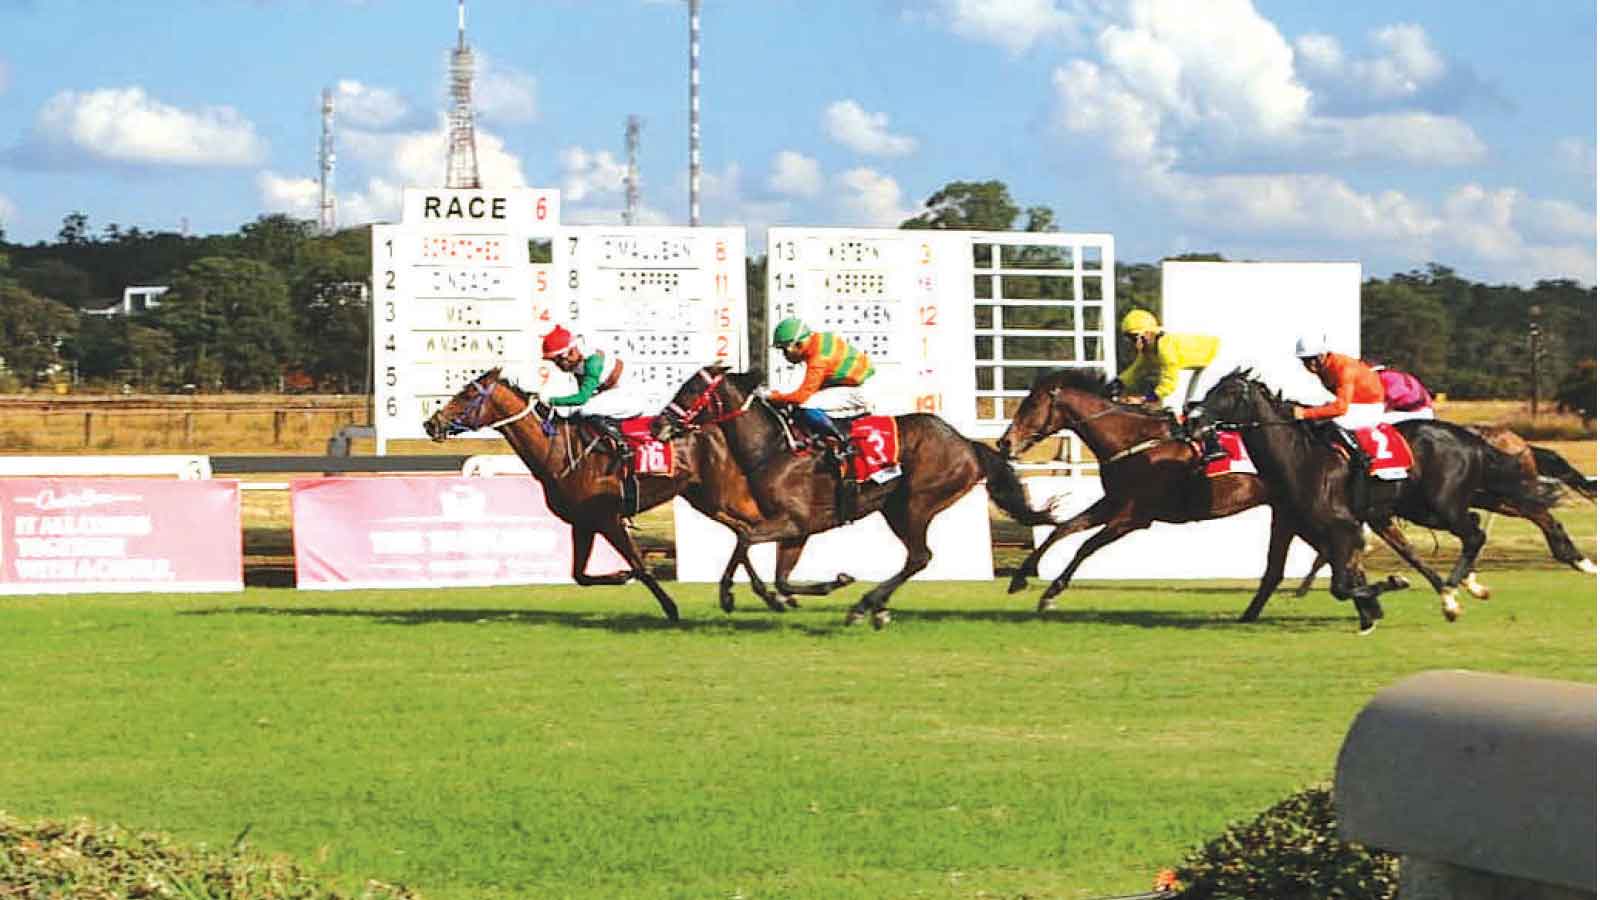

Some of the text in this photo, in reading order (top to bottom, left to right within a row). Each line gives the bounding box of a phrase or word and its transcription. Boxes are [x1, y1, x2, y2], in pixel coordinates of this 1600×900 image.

[423, 195, 548, 221] RACE 6
[385, 239, 393, 258] 1
[567, 235, 579, 256] 7
[775, 240, 796, 262] 13
[385, 269, 549, 293] 2 5
[567, 268, 730, 296] 8 11
[385, 301, 396, 323] 3
[919, 304, 938, 327] 12
[385, 333, 396, 353] 4
[715, 334, 729, 358] 2
[385, 365, 398, 387] 5
[385, 395, 398, 418] 6
[866, 430, 889, 466] 3
[1371, 430, 1393, 460] 2
[639, 441, 669, 474] 16
